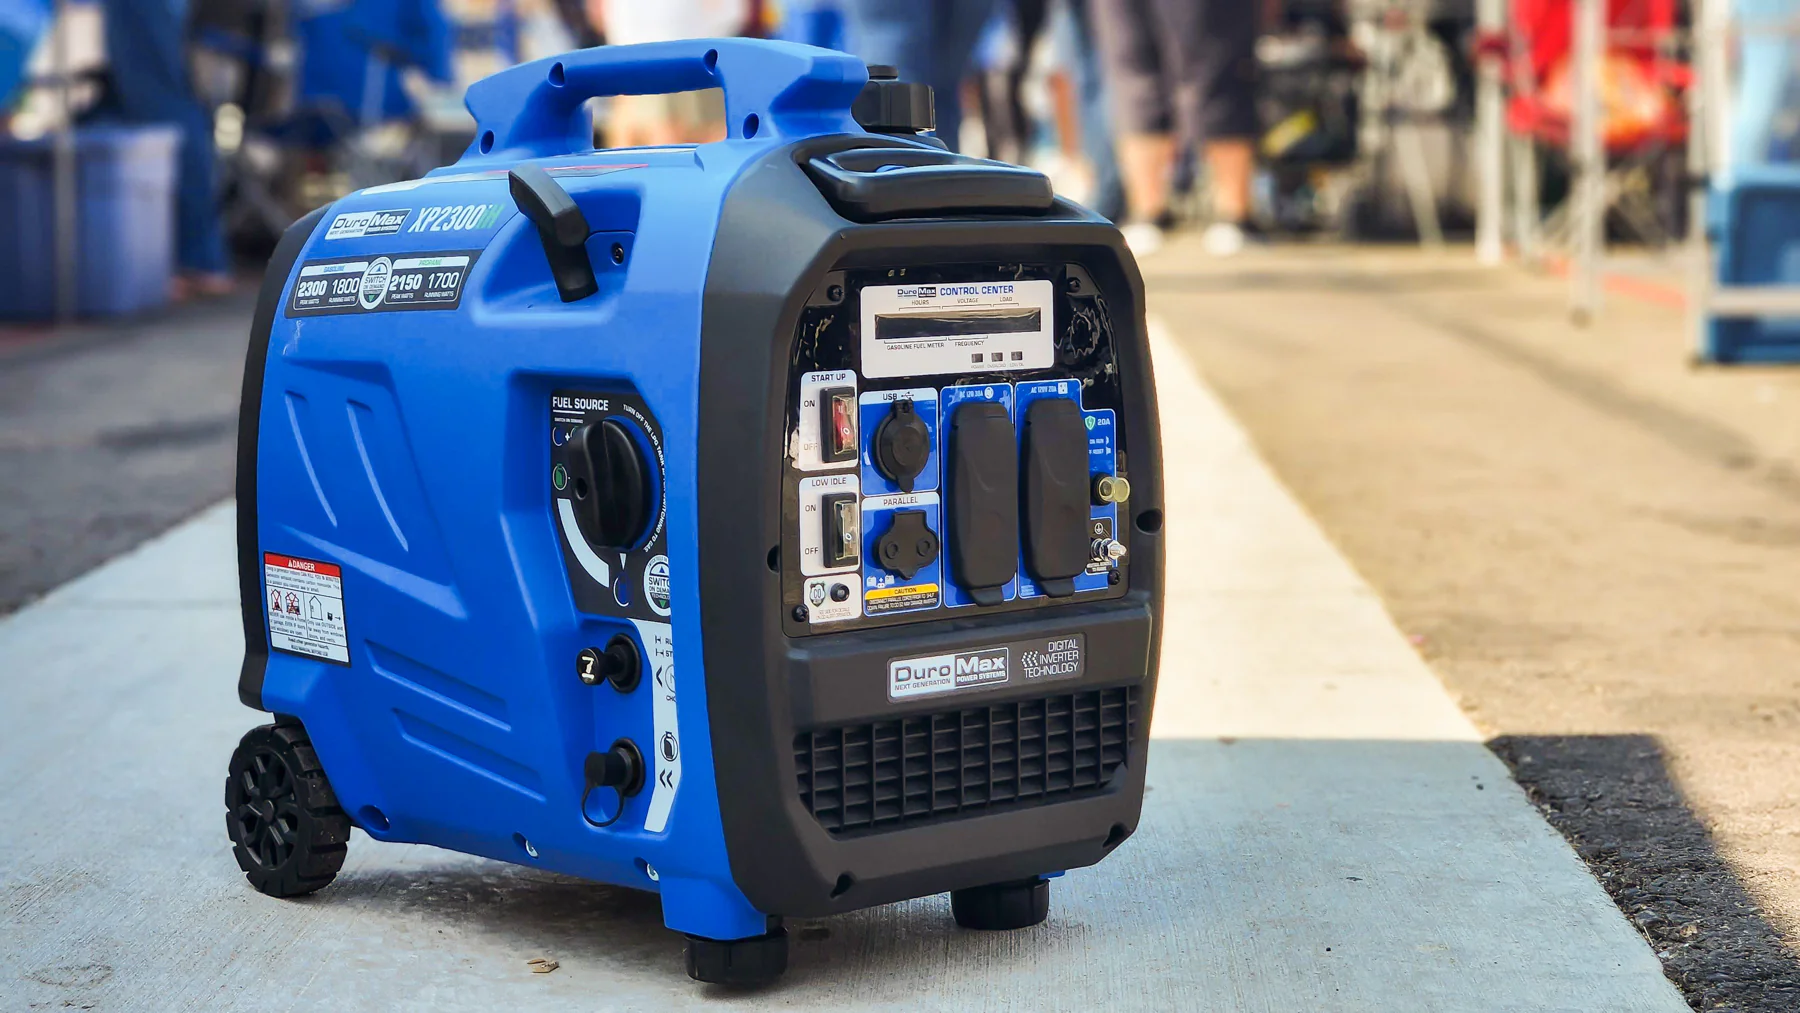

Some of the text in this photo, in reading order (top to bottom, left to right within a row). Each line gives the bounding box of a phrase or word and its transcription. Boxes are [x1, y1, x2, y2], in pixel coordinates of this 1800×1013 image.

[332, 278, 360, 295] 1800
[389, 274, 423, 291] 2150
[428, 272, 460, 289] 1700
[298, 280, 328, 297] 2300
[940, 286, 979, 296] CONTROL
[981, 285, 1014, 294] CENTER
[811, 373, 846, 382] START UP
[552, 396, 609, 411] FUEL SOURCE
[882, 393, 898, 401] USB
[803, 400, 816, 408] ON
[623, 403, 636, 415] TURN
[635, 411, 645, 422] OFF
[643, 420, 653, 433] THE
[1097, 417, 1111, 426] 20A
[803, 443, 818, 451] OFF
[811, 477, 847, 487] LOW IDLE
[883, 496, 919, 506] PARALLEL
[804, 504, 817, 512] ON
[804, 547, 819, 555] OFF
[292, 559, 316, 572] DANGER
[648, 576, 670, 588] SWITC
[894, 587, 917, 595] CAUTION
[1048, 638, 1079, 652] DIGITAL
[1039, 650, 1079, 664] INVERTER
[895, 655, 1005, 683] DuroMax
[1023, 661, 1079, 679] TECHNOLOGY
[956, 670, 1006, 683] POWER SYSTEMS
[894, 678, 951, 691] NEXT GENERATION
